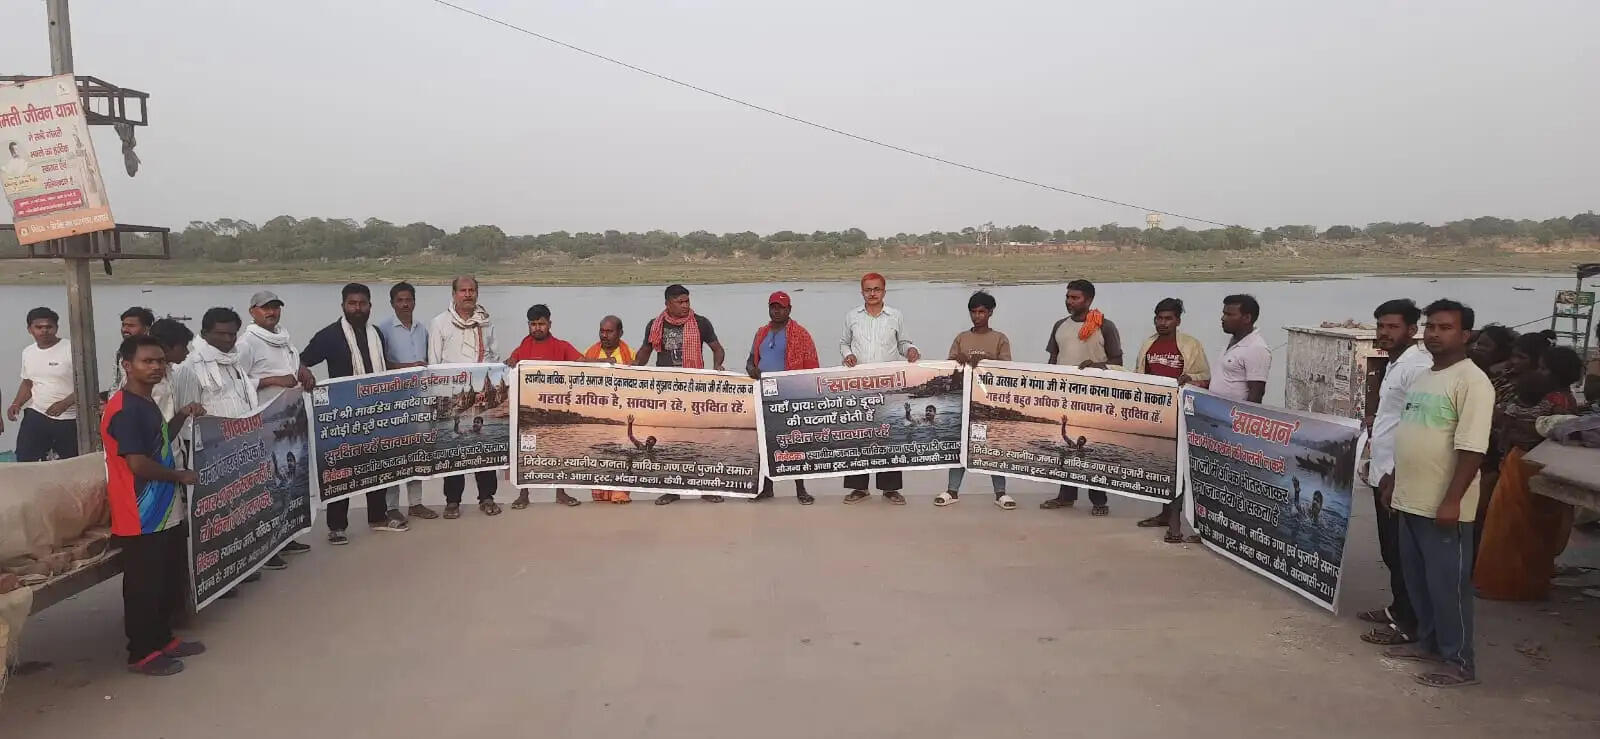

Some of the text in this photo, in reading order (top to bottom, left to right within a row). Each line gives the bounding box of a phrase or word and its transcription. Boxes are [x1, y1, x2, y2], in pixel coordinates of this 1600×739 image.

[23, 103, 54, 123] जीवन
[54, 102, 78, 118] यात्रा
[420, 374, 450, 392] दुर्घटना
[525, 370, 546, 384] स्थानीय
[569, 372, 585, 389] पुजारी
[586, 375, 604, 386] समाज
[605, 373, 614, 387] एवं
[656, 380, 672, 394] सुझाव
[673, 378, 687, 391] लेकर
[708, 380, 715, 393] जी
[737, 384, 747, 394] तक
[996, 375, 1018, 388] उत्साह
[1020, 374, 1028, 388] में
[1029, 375, 1044, 390] गंगा
[1046, 378, 1058, 392] जी
[1059, 378, 1068, 392] में
[1068, 382, 1087, 395] स्नान
[1089, 384, 1109, 397] करना
[1111, 387, 1133, 400] घातक
[1133, 387, 1141, 402] हो
[1144, 391, 1166, 406] सकता
[318, 396, 437, 422] यहाँ श्री महादेव घाट
[538, 391, 571, 405] गहराई
[575, 392, 609, 406] अधिक
[627, 397, 667, 410] सावधान
[691, 399, 727, 415] सुरक्षित
[769, 400, 789, 413] यहाँ
[816, 396, 843, 410] लोगों
[845, 396, 857, 407] के
[858, 393, 884, 409] डूबने
[986, 391, 1011, 404] गहराई
[1013, 394, 1031, 408] बहुत
[1033, 394, 1059, 408] अधिक
[1070, 399, 1102, 413] सावधान
[1120, 406, 1149, 421] सुरक्षित
[320, 426, 329, 439] में
[329, 423, 350, 439] थोड़ी
[351, 420, 362, 434] ही
[363, 419, 376, 435] दूरी
[377, 419, 390, 429] पर
[391, 413, 409, 427] पानी
[411, 412, 431, 422] गहरा
[786, 408, 875, 427] की घटनाएँ होती हैं
[324, 429, 438, 466] सुरक्षित रहें सावधान रहें
[776, 424, 890, 448] सुरक्षित रहें सावधान रहें
[354, 459, 382, 476] स्थानीय
[461, 442, 484, 460] पुजारी
[806, 447, 834, 460] स्थानीय
[862, 443, 887, 455] नाविक
[888, 444, 903, 453] गण
[904, 441, 916, 452] एवं
[916, 439, 940, 455] पुजारी
[564, 456, 597, 467] स्थानीय
[600, 460, 629, 469] जनता,
[632, 459, 661, 471] नाविक
[664, 464, 680, 472] गण
[682, 462, 697, 473] एवं
[697, 462, 724, 477] पुजारी
[726, 465, 753, 476] समाज
[570, 473, 592, 481] आशा
[814, 462, 832, 471] आशा
[1006, 450, 1034, 461] स्थानीय
[1064, 457, 1089, 469] नाविक
[1090, 463, 1106, 472] गण
[1107, 464, 1121, 474] एवं
[1121, 467, 1144, 480] पुजारी
[1145, 471, 1170, 483] समाज
[1011, 463, 1029, 473] आशा
[1245, 499, 1272, 522] सकता
[1250, 527, 1271, 546] नाविक
[1272, 538, 1286, 554] गण
[1286, 544, 1298, 558] एवं
[1297, 549, 1320, 569] पुजारी
